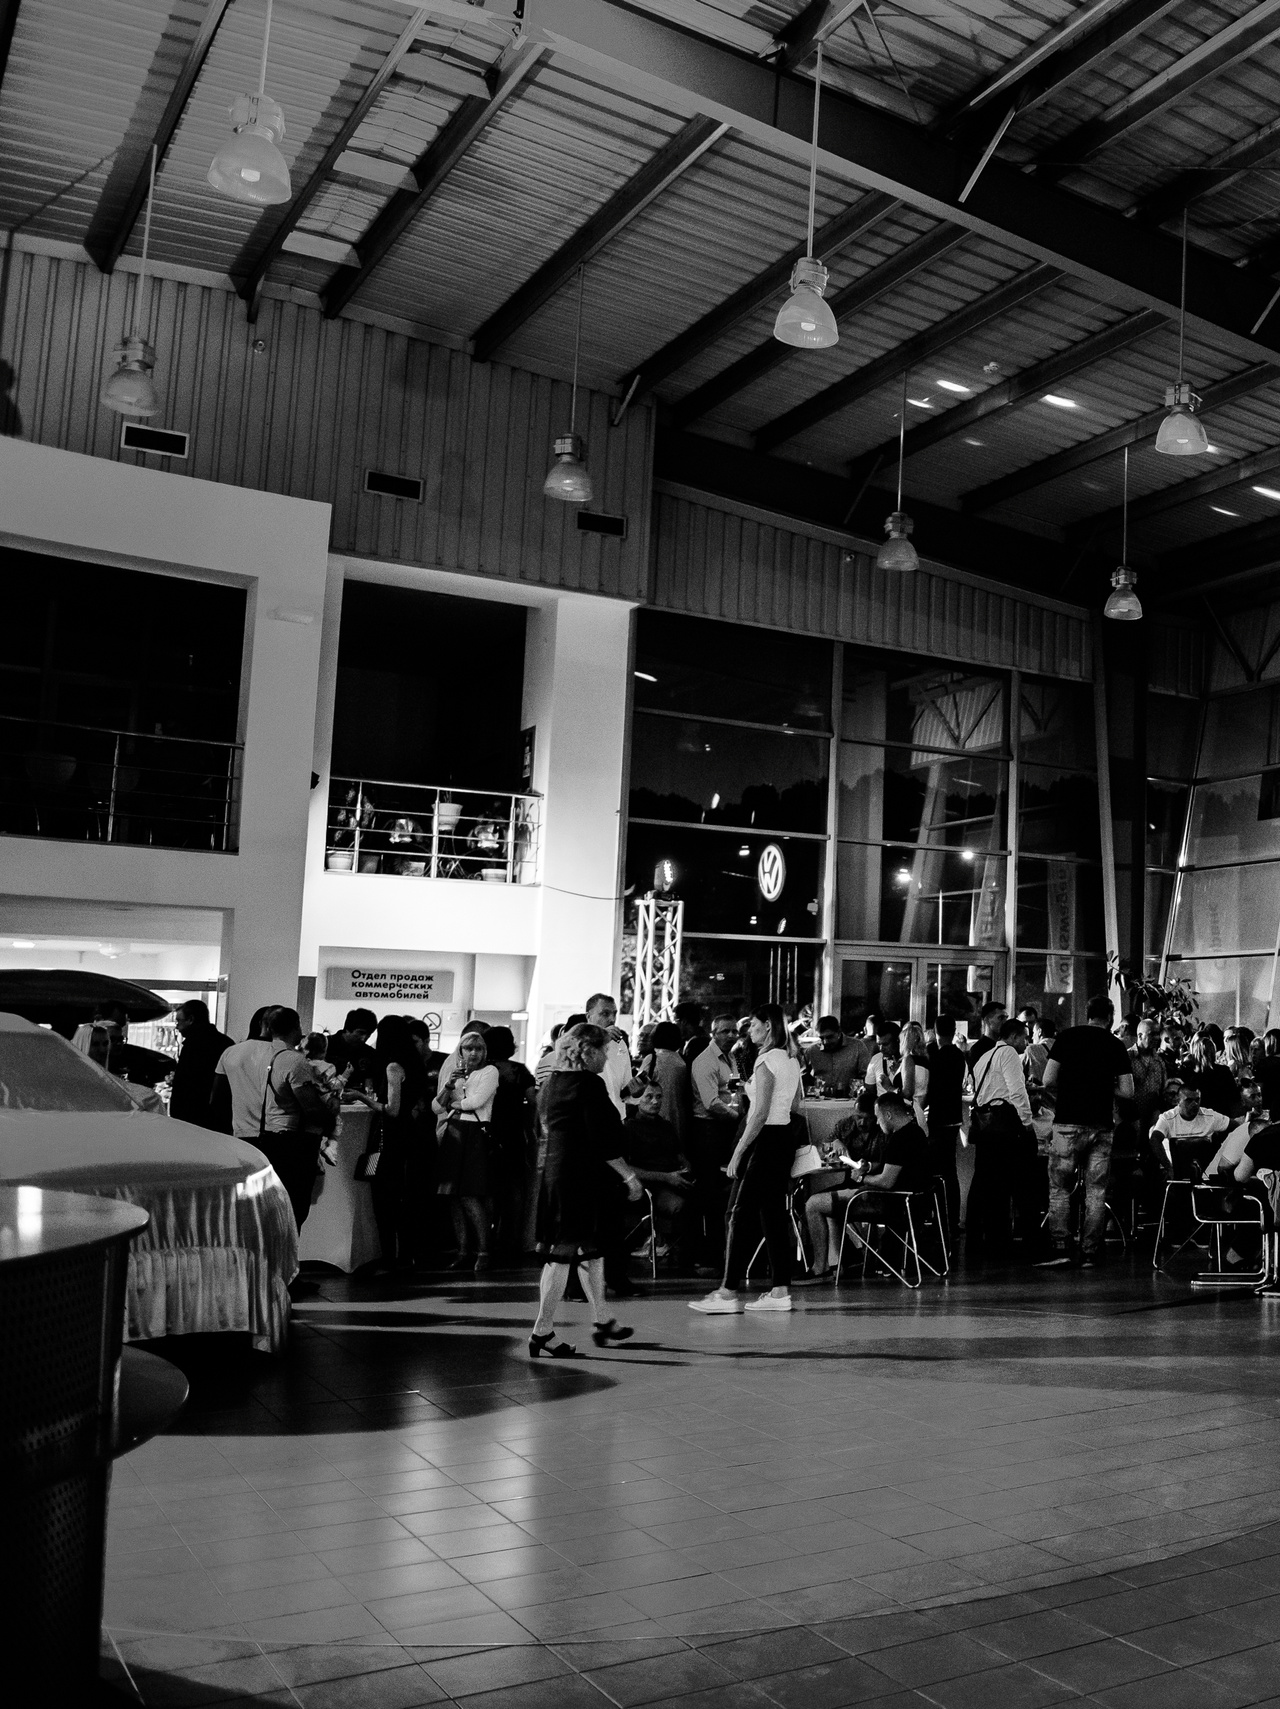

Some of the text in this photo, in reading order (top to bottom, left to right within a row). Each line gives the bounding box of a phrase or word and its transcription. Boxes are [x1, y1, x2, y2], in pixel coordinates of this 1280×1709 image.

[351, 969, 434, 982] Отдел продаж
[351, 981, 433, 990] коммерческих
[355, 990, 429, 1000] автомобилей
